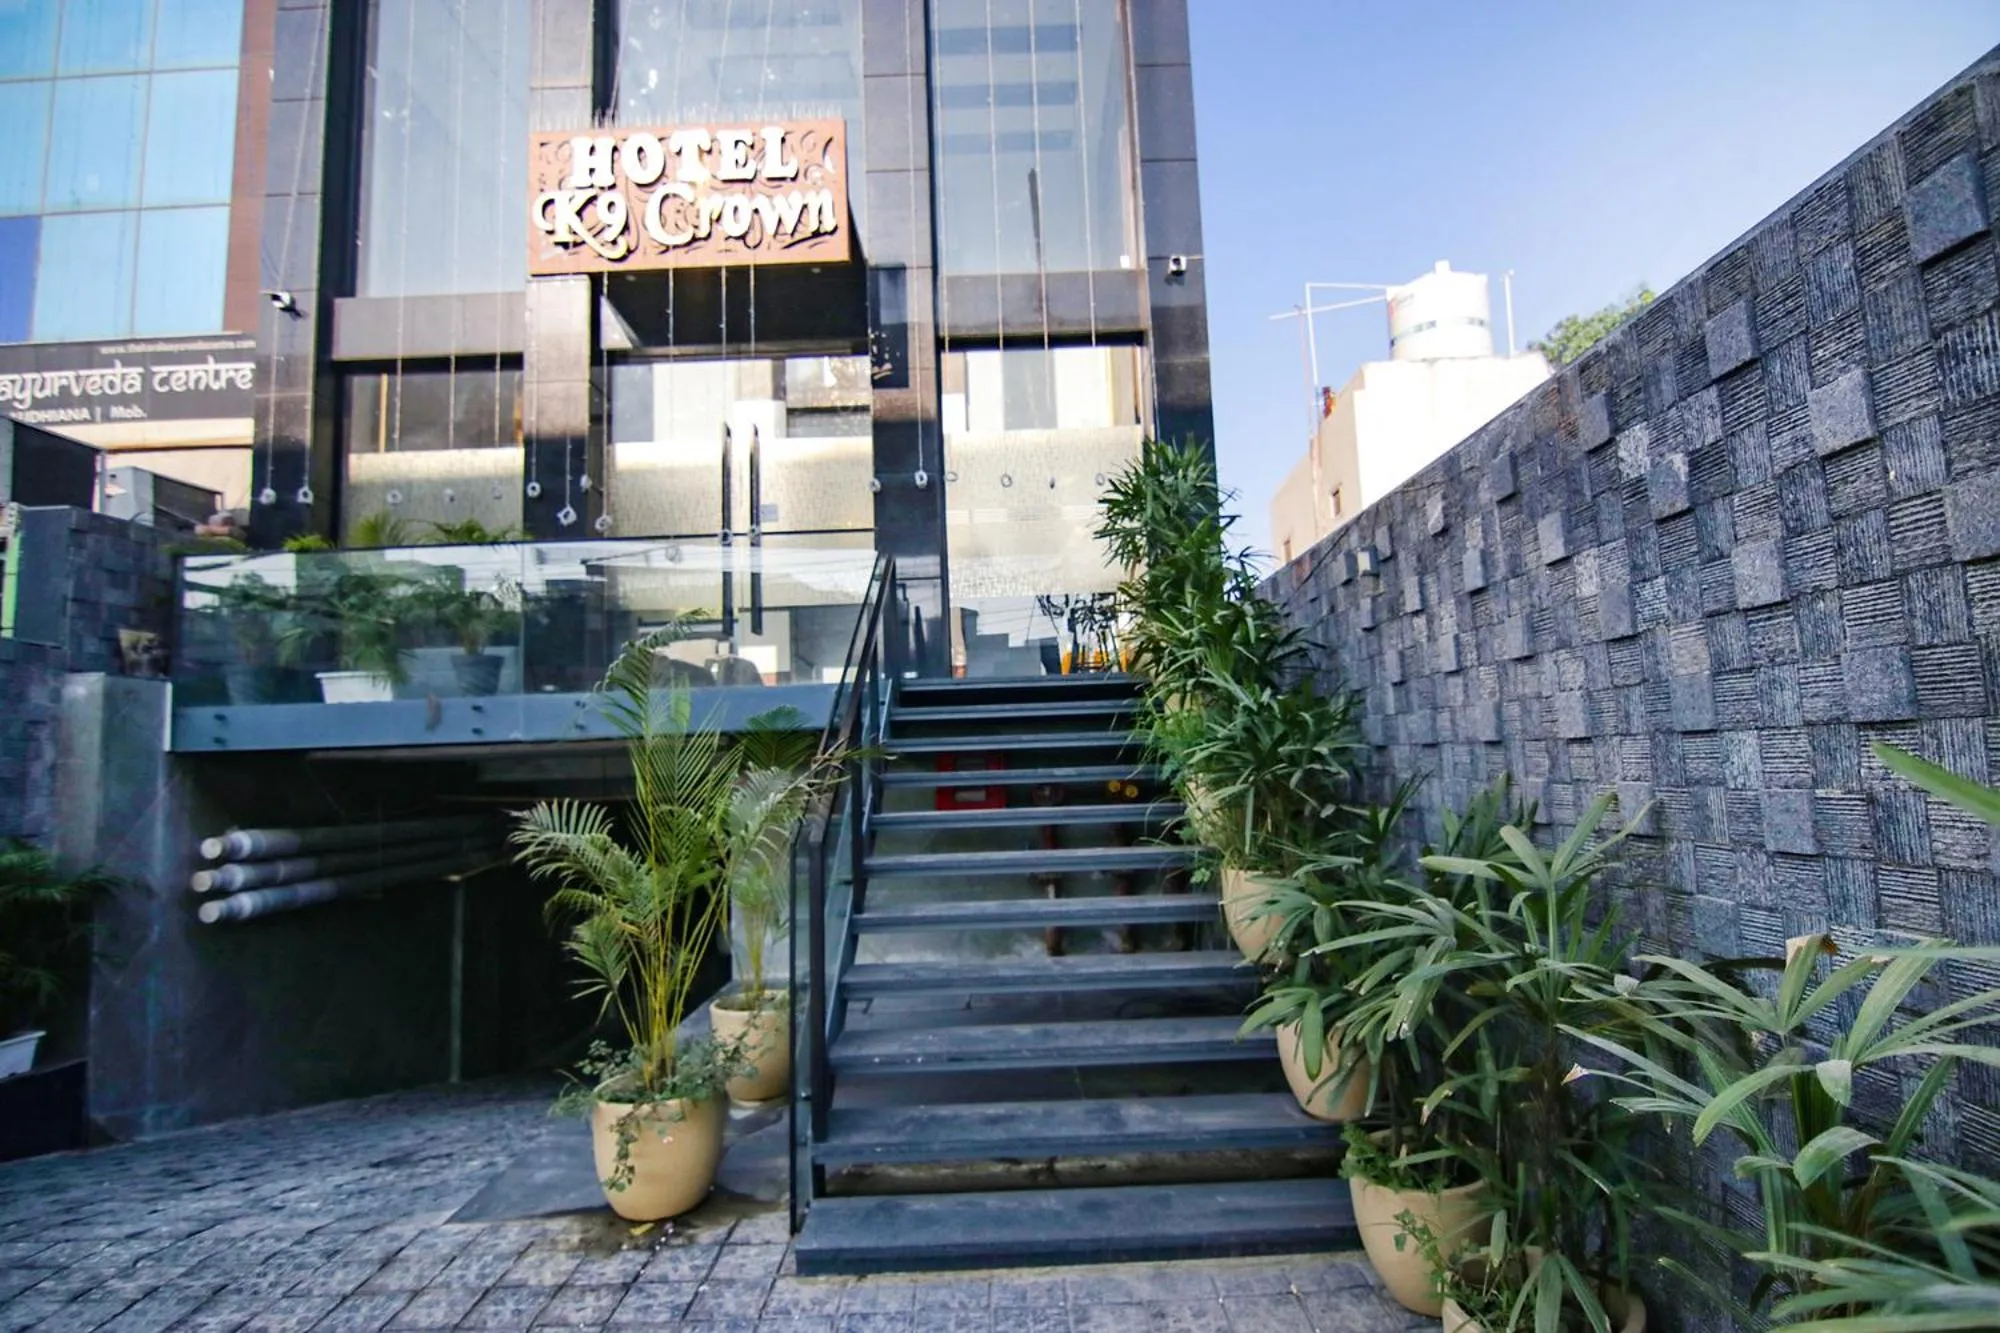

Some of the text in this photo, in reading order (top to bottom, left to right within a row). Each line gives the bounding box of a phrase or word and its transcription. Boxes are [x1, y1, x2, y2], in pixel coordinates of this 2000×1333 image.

[569, 127, 799, 188] HOTEL
[532, 182, 837, 261] K9 Crown
[0, 354, 256, 409] ayurveda centre
